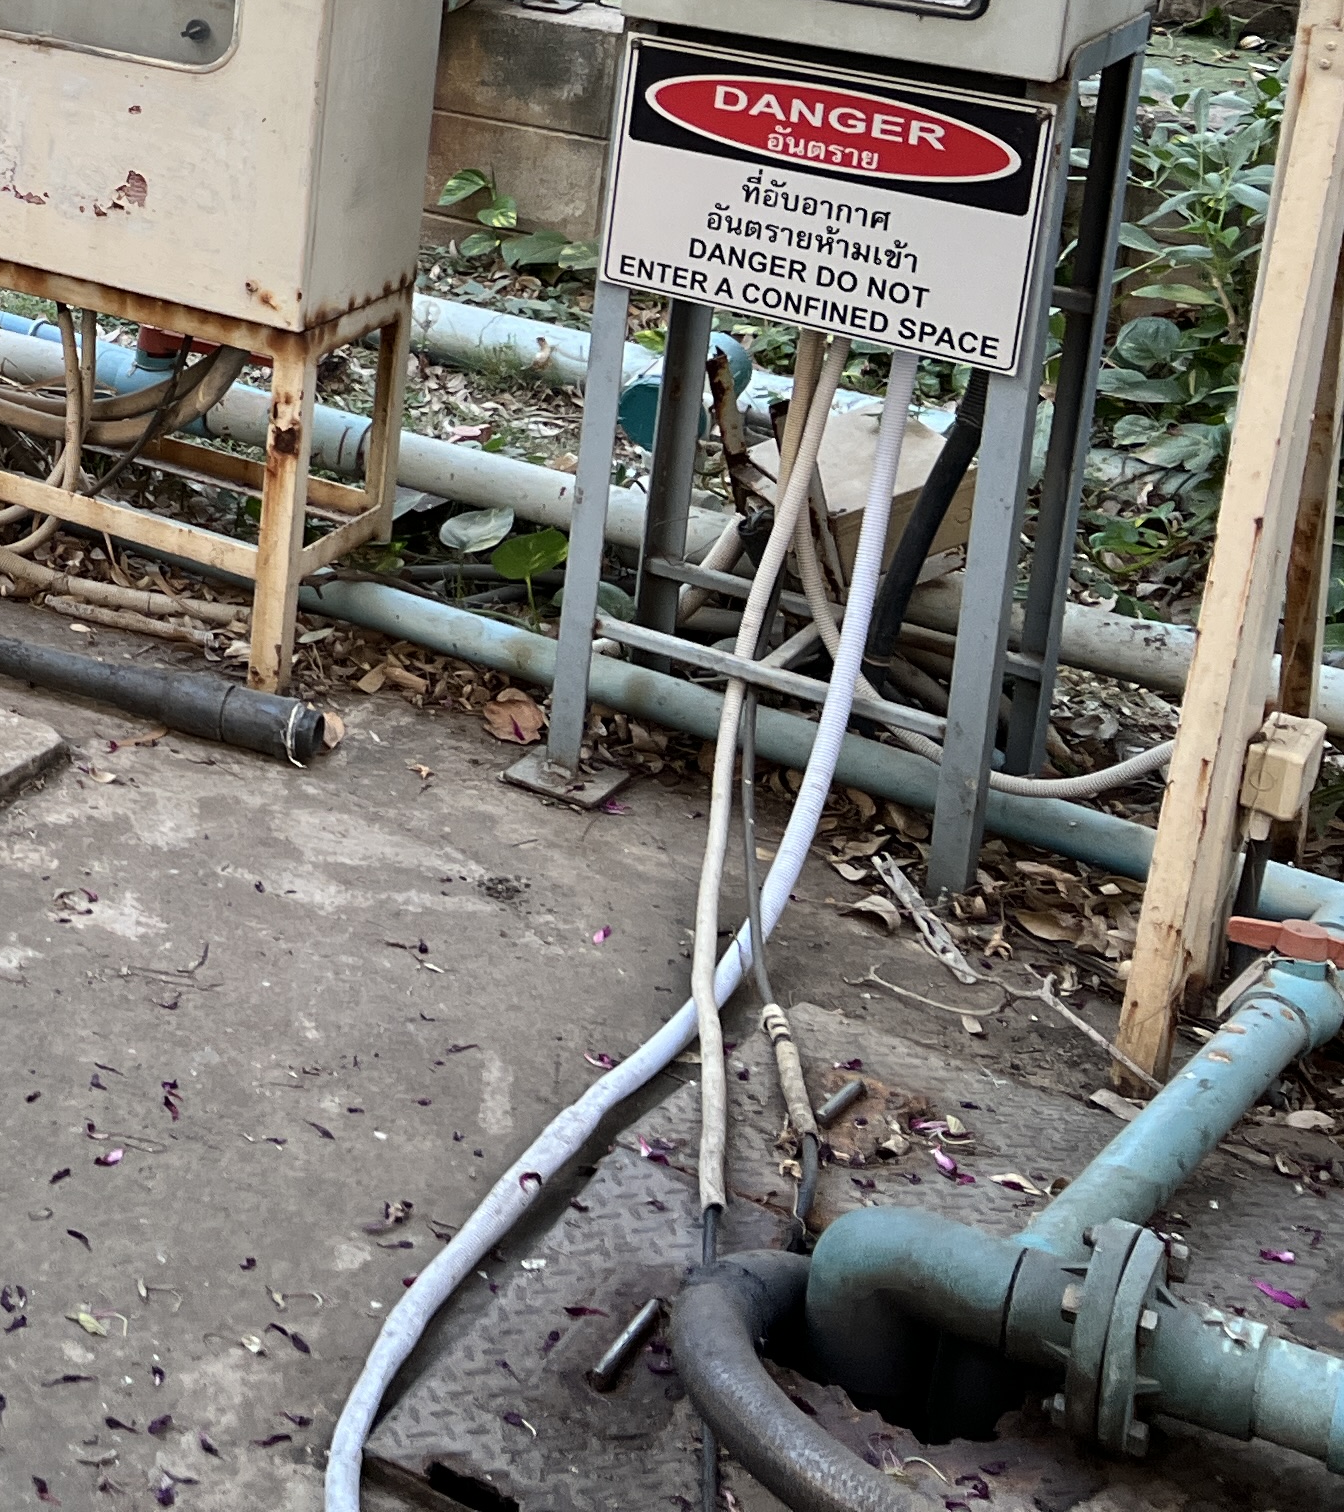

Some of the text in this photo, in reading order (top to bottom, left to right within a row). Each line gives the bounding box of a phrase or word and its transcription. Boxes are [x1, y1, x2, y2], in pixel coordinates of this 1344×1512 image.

[714, 85, 946, 151] DANGER
[767, 125, 879, 170] อันตราย
[742, 169, 891, 231] ที่อับอากาศ
[707, 202, 918, 273] อันตรายห้ามเข้า
[620, 254, 1000, 359] ENTER A CONFINED SPACE
[689, 238, 930, 308] DANGER DO NOT
